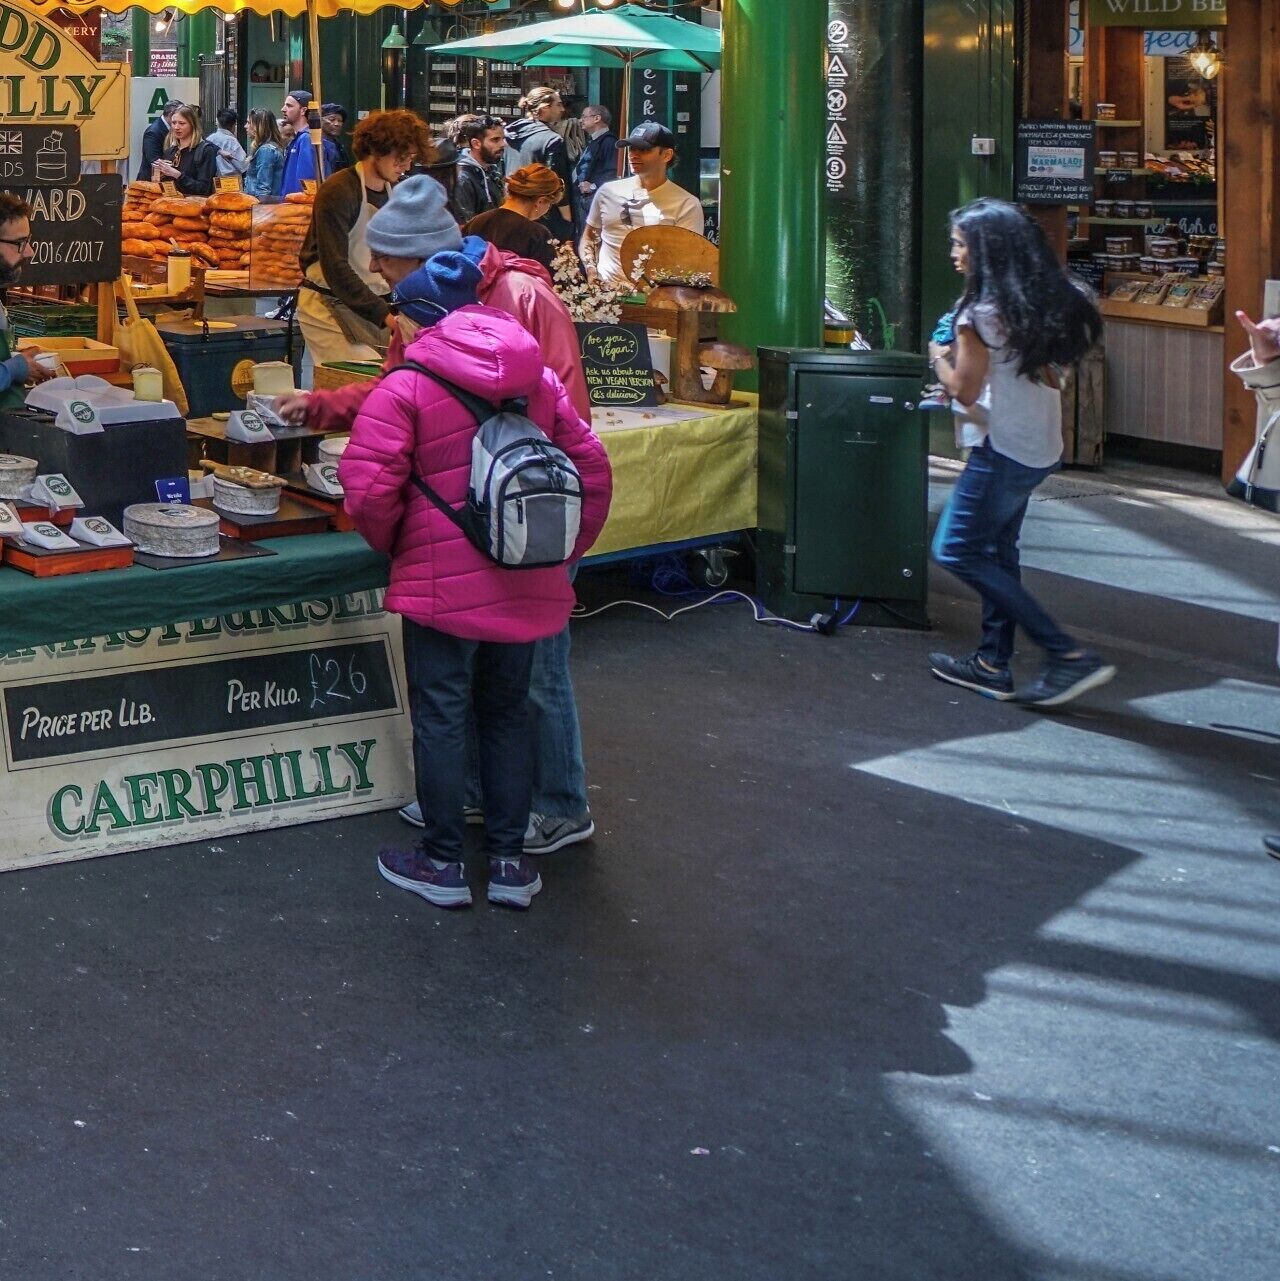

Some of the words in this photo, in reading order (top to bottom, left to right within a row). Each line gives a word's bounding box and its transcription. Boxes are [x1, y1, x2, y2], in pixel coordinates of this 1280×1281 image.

[830, 161, 840, 172] 5
[30, 241, 104, 265] 2016/2017
[587, 335, 601, 345] Are
[604, 335, 626, 349] you
[598, 340, 635, 362] Vegan?
[585, 367, 600, 376] Ask
[601, 368, 611, 376] us
[613, 367, 634, 376] about
[587, 376, 603, 385] NEW
[606, 376, 628, 386] VEGAN
[629, 377, 654, 387] VERSION
[593, 390, 605, 399] it's
[606, 389, 639, 400] delicious
[309, 653, 367, 709] £26
[227, 679, 262, 714] PER
[264, 680, 301, 708] KILO.
[20, 706, 76, 740] PRICE
[78, 709, 112, 733] PER
[51, 739, 377, 837] CAERPHILLY
